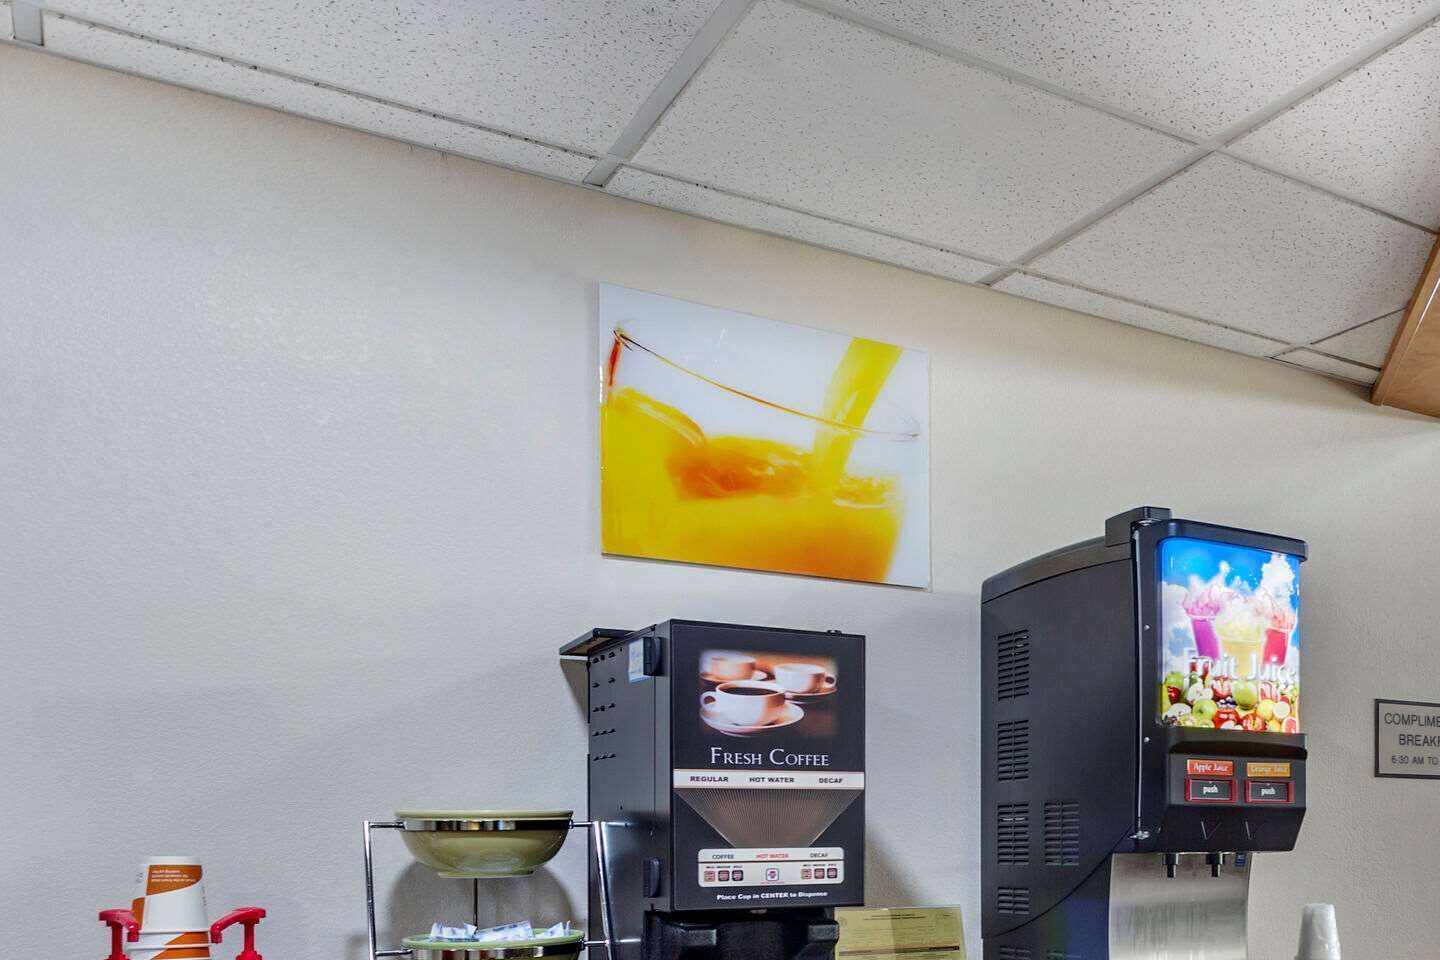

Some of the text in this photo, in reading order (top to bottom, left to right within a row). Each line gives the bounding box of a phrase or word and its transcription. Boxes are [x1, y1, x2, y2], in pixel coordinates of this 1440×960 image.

[1412, 756, 1425, 765] AM
[1427, 756, 1439, 766] TO
[1203, 785, 1219, 795] push
[1261, 787, 1276, 797] push
[738, 893, 752, 901] Cup
